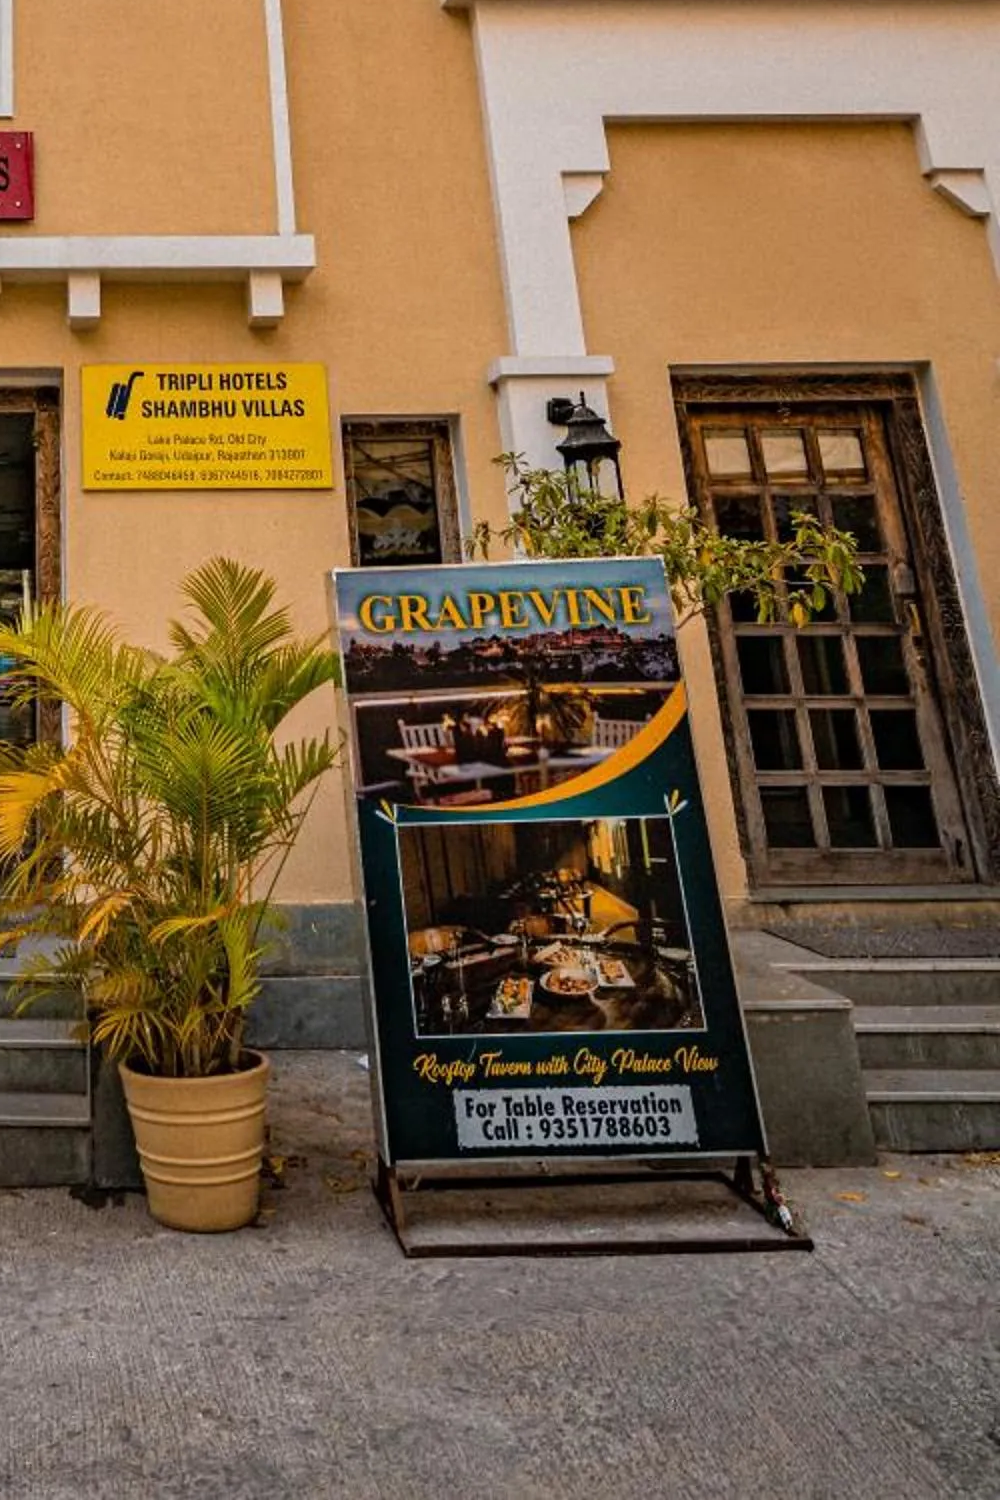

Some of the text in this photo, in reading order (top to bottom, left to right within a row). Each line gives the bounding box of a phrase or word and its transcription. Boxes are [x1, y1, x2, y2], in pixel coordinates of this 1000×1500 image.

[156, 371, 288, 391] TRIPLI HOTELS
[141, 399, 306, 419] SHAMBHU VILLAS
[227, 433, 245, 445] Old
[247, 433, 267, 447] City
[217, 449, 267, 462] Rajasthan
[359, 586, 652, 635] GRAPEVINE
[413, 1045, 721, 1086] Rooftop Tavern with City Palace View
[465, 1091, 683, 1119] For Table Reservation
[482, 1119, 520, 1141] Call
[539, 1115, 672, 1140] 9351788603
